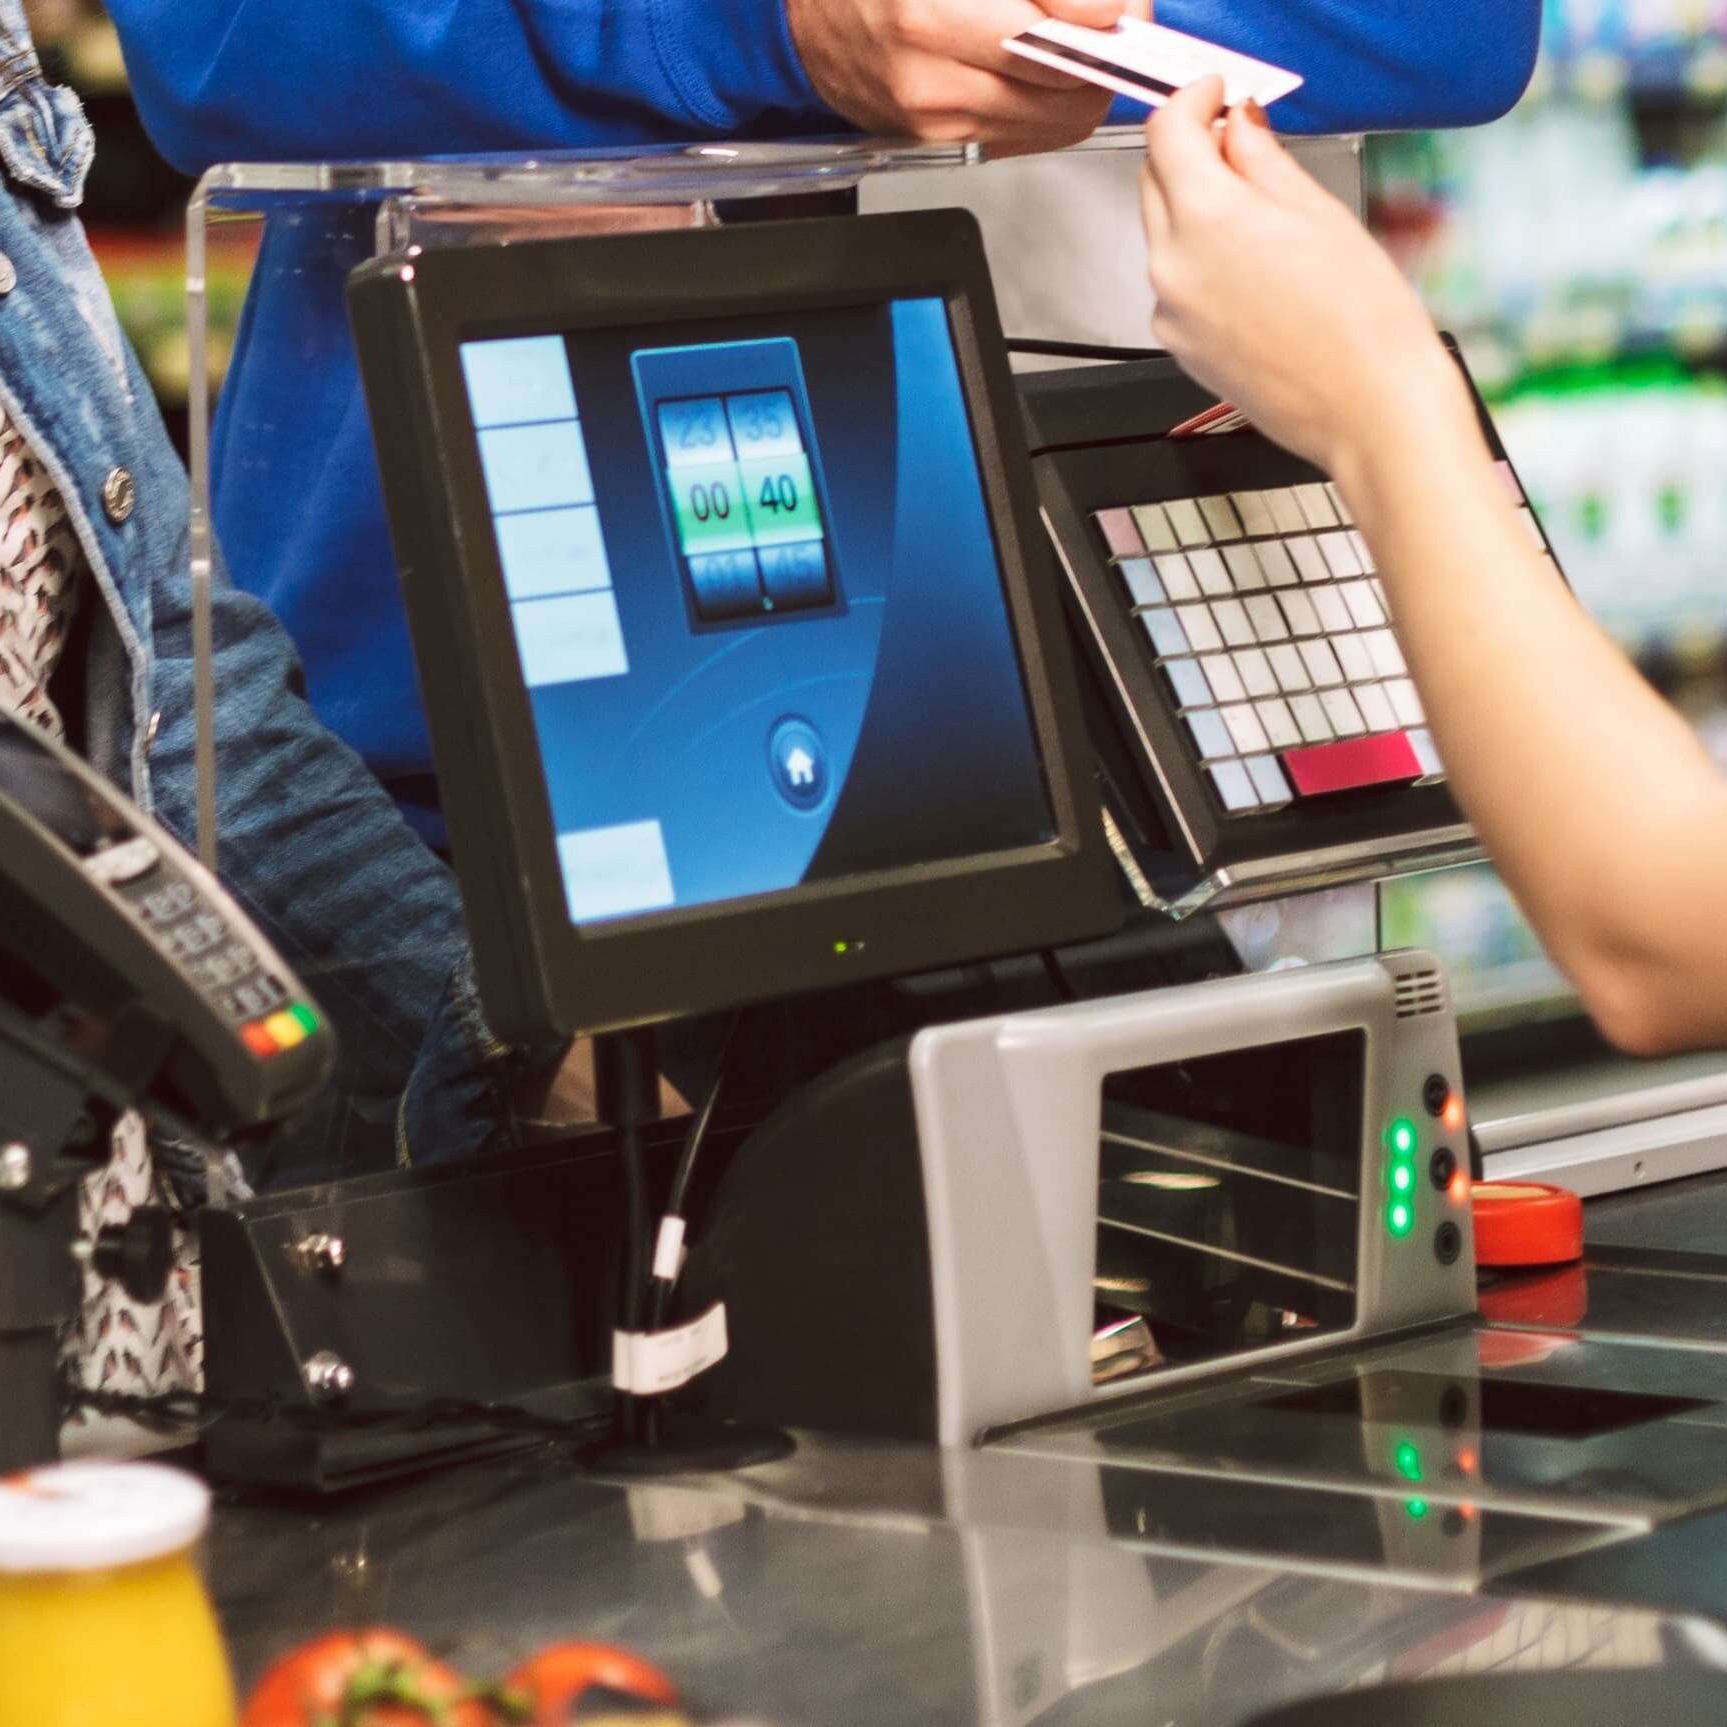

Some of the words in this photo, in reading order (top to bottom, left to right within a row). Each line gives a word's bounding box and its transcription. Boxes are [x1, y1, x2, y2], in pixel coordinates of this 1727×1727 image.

[677, 408, 719, 449] 23
[742, 401, 784, 442] 35
[689, 481, 730, 522] 00
[760, 474, 798, 514] 40
